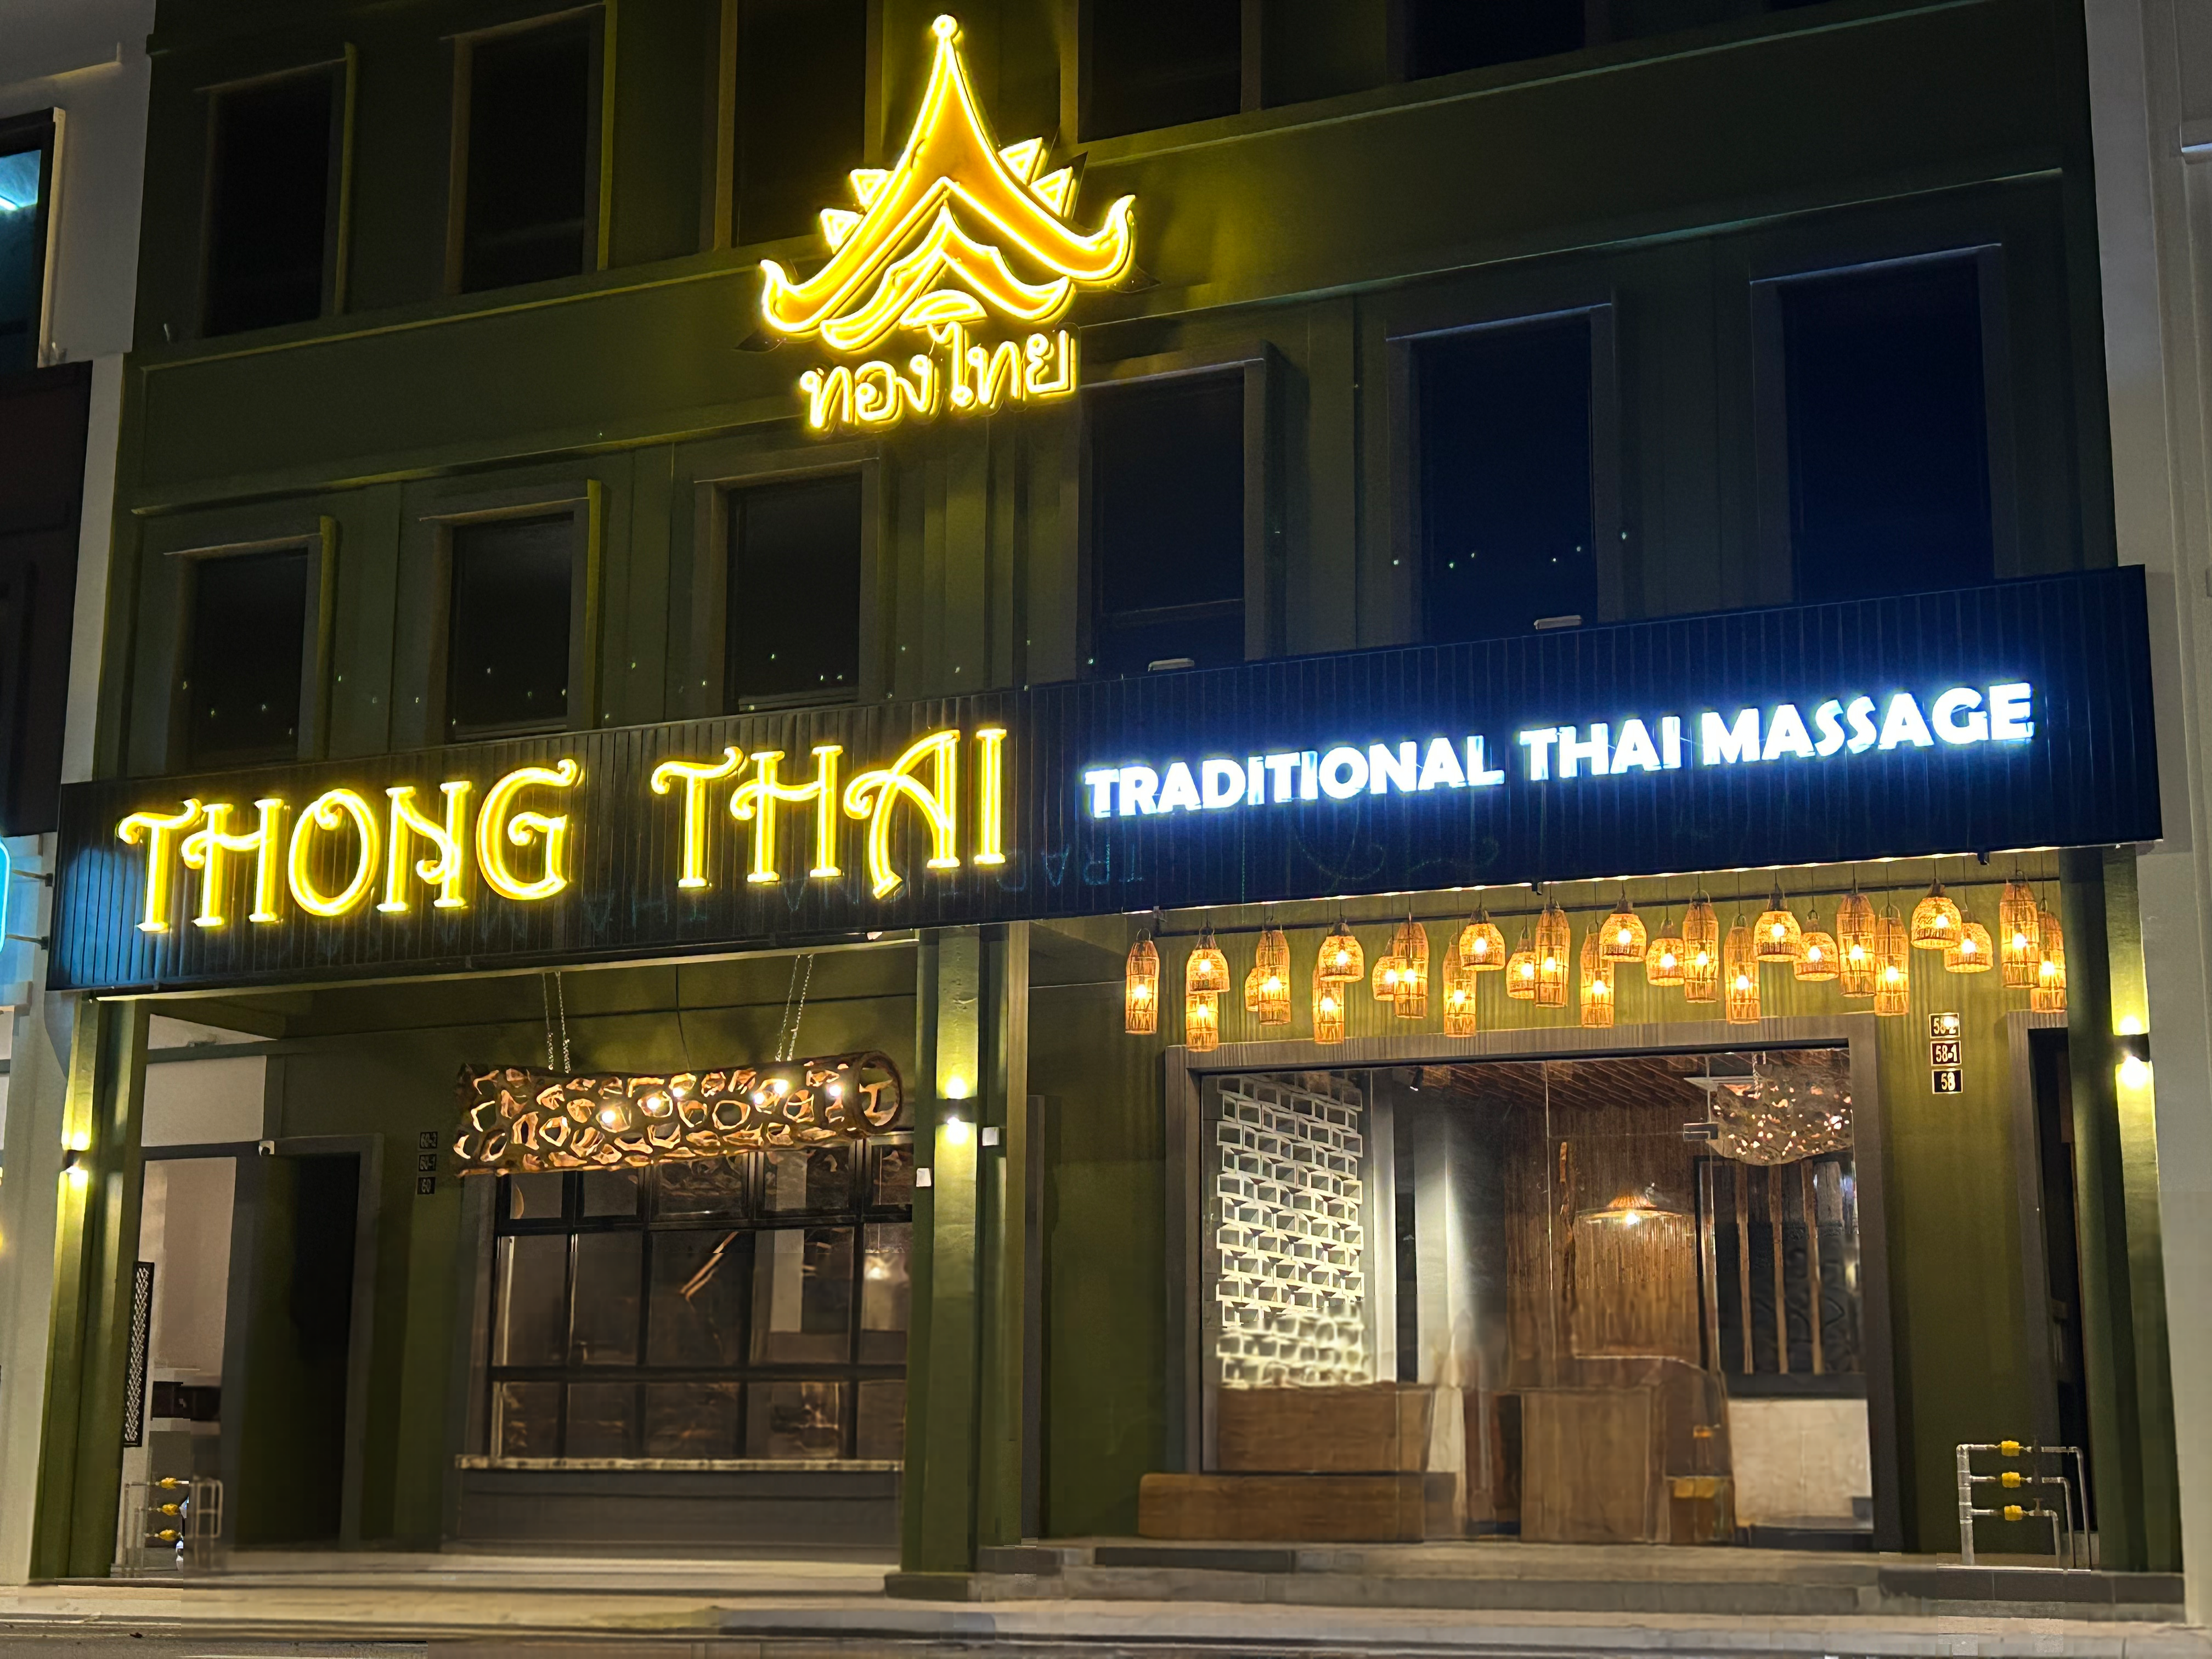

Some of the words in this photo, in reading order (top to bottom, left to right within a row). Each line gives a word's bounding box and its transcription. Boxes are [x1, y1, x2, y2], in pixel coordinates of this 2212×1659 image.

[800, 321, 1074, 429] ทองไทย
[1084, 734, 1505, 818] TRADITIONAL
[1519, 715, 1682, 781] THAI
[1701, 681, 2034, 766] MASSAGE
[118, 758, 579, 934] THONG
[651, 727, 1008, 899] THAI
[1936, 1044, 1957, 1062] 58-1
[1941, 1071, 1955, 1091] 58
